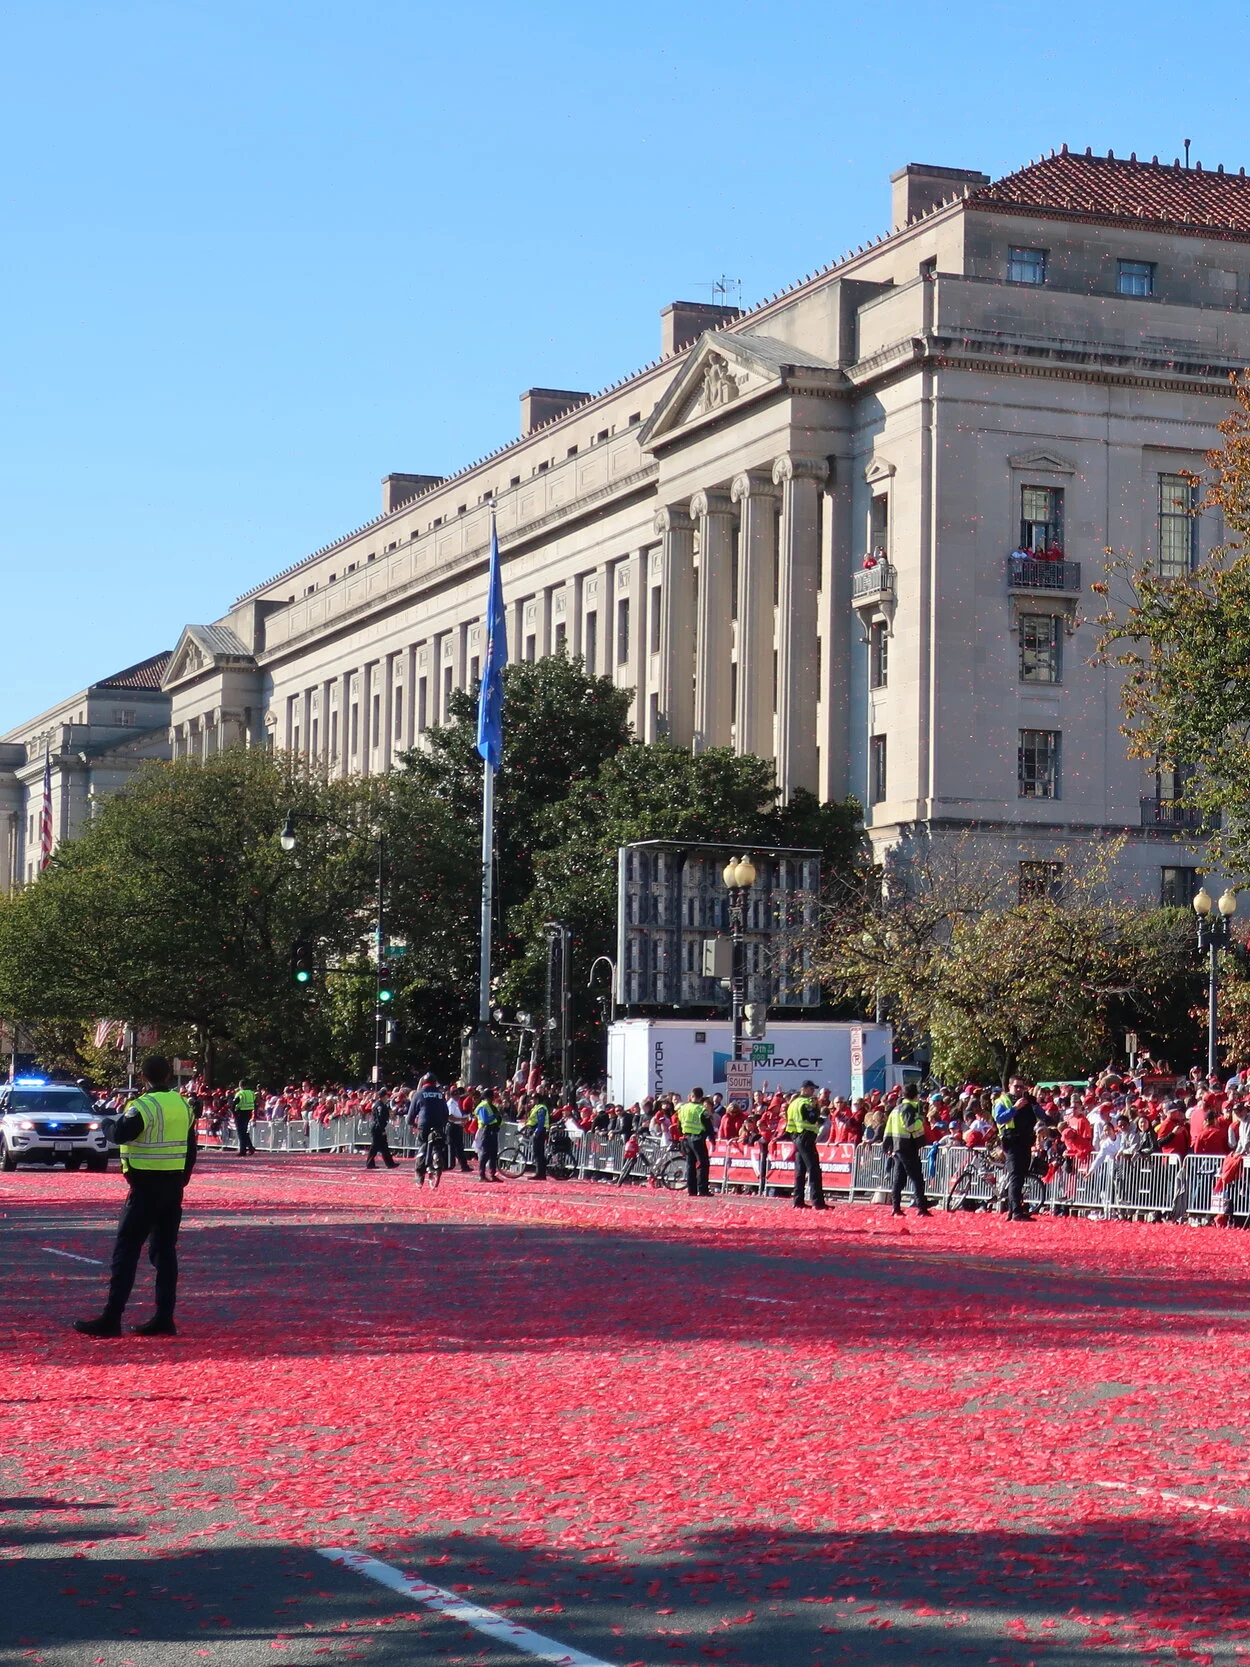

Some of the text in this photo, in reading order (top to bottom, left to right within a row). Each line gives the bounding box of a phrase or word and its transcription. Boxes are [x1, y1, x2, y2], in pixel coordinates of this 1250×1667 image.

[753, 1044, 767, 1054] 9th
[730, 1063, 748, 1072] ALT
[754, 1058, 823, 1068] MPACT
[729, 1077, 751, 1087] SOUTH
